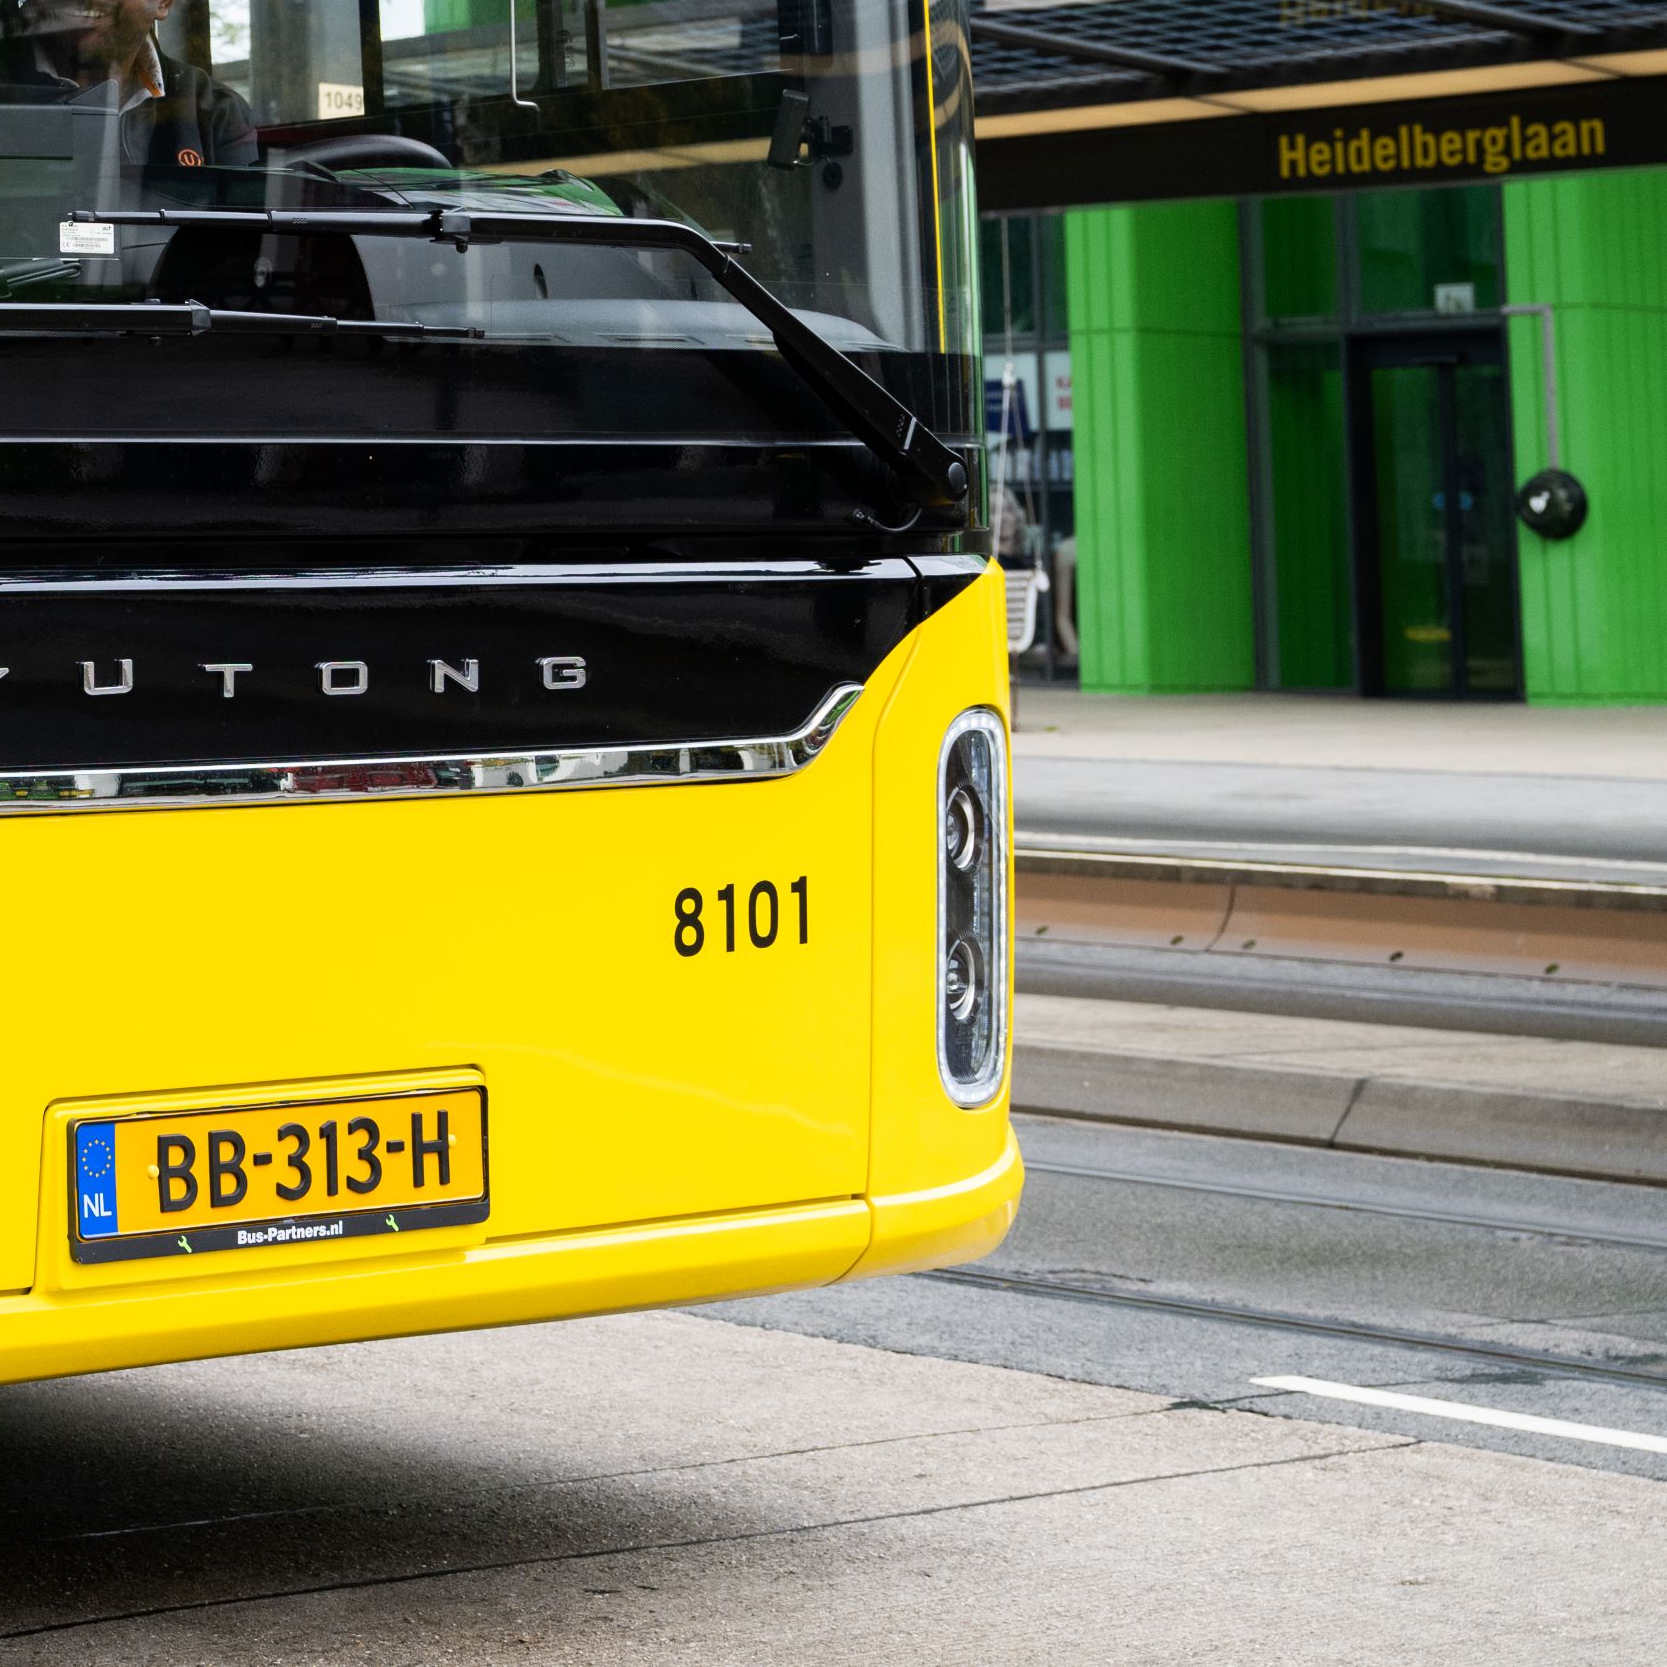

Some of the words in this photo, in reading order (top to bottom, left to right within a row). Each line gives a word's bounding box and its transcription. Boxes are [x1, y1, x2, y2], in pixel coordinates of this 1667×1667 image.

[1277, 114, 1606, 180] Heidelberglaan
[674, 875, 808, 958] 8101
[157, 1109, 450, 1213] BB-313-H
[83, 1193, 113, 1219] NL
[237, 1221, 344, 1245] Bus-Partners.nl
